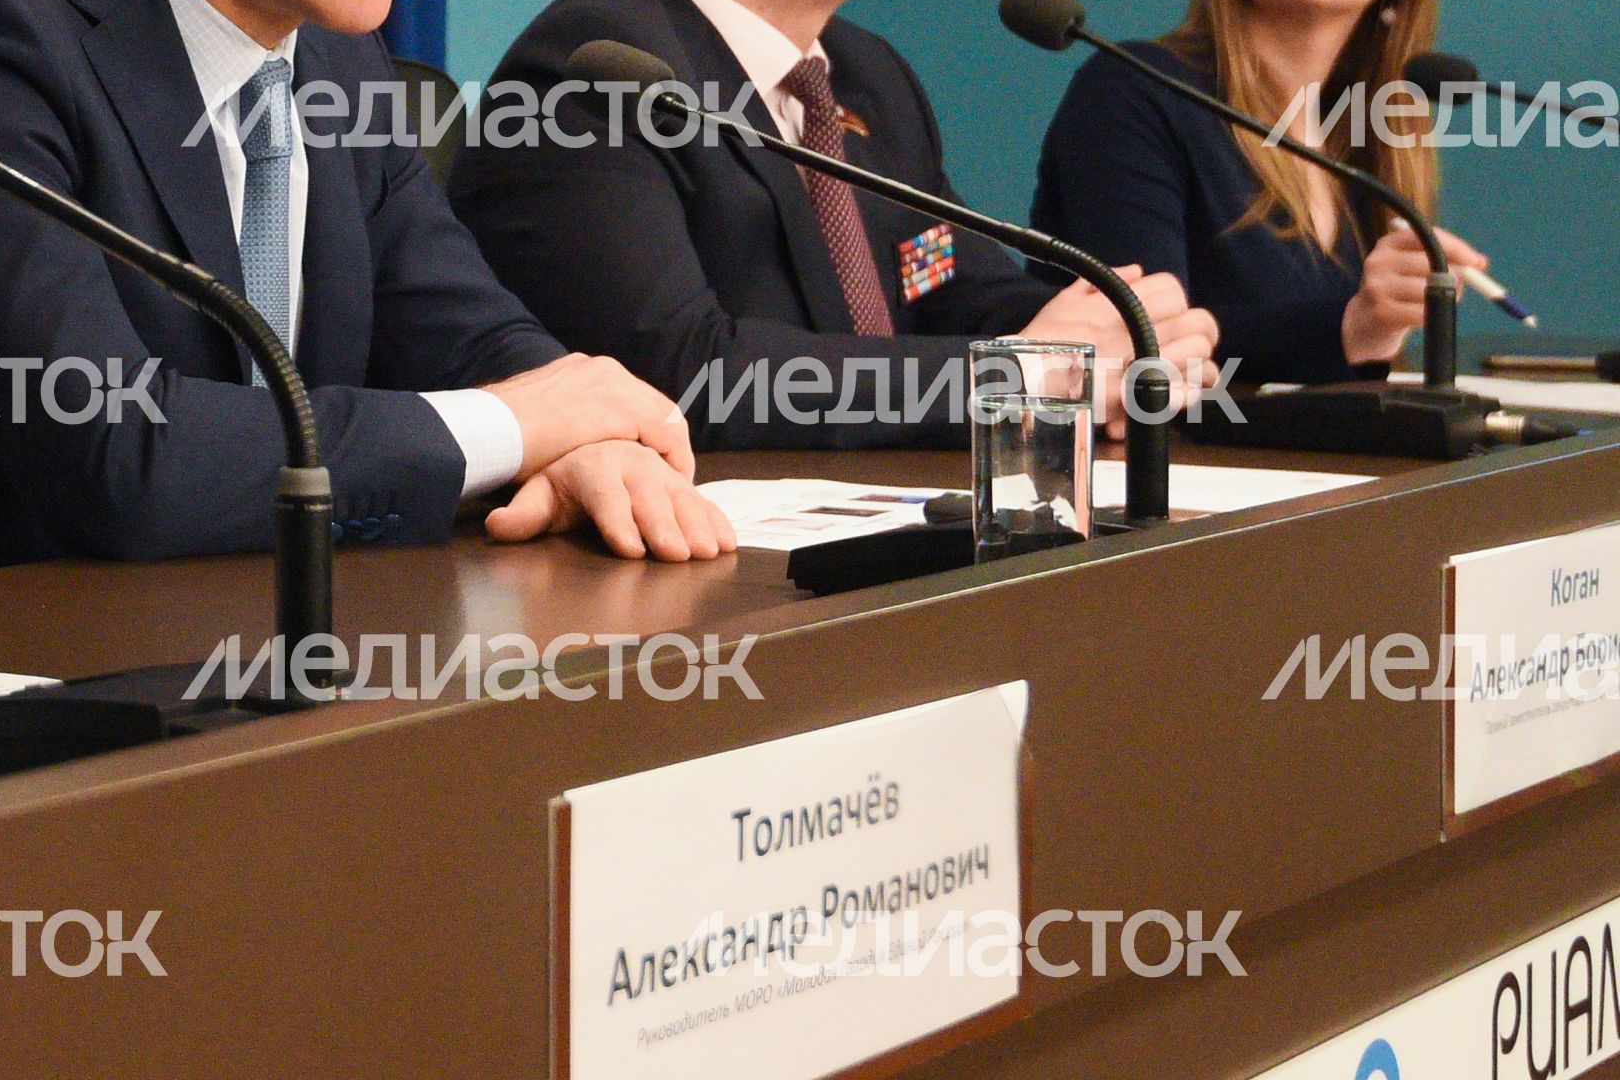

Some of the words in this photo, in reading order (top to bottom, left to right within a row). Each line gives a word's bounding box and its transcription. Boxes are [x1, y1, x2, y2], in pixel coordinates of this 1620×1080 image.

[1551, 567, 1600, 607] Коган
[1470, 646, 1570, 703] Александр
[731, 772, 900, 862] Толмачёв
[606, 903, 810, 1007] Александр
[821, 843, 991, 938] Романович
